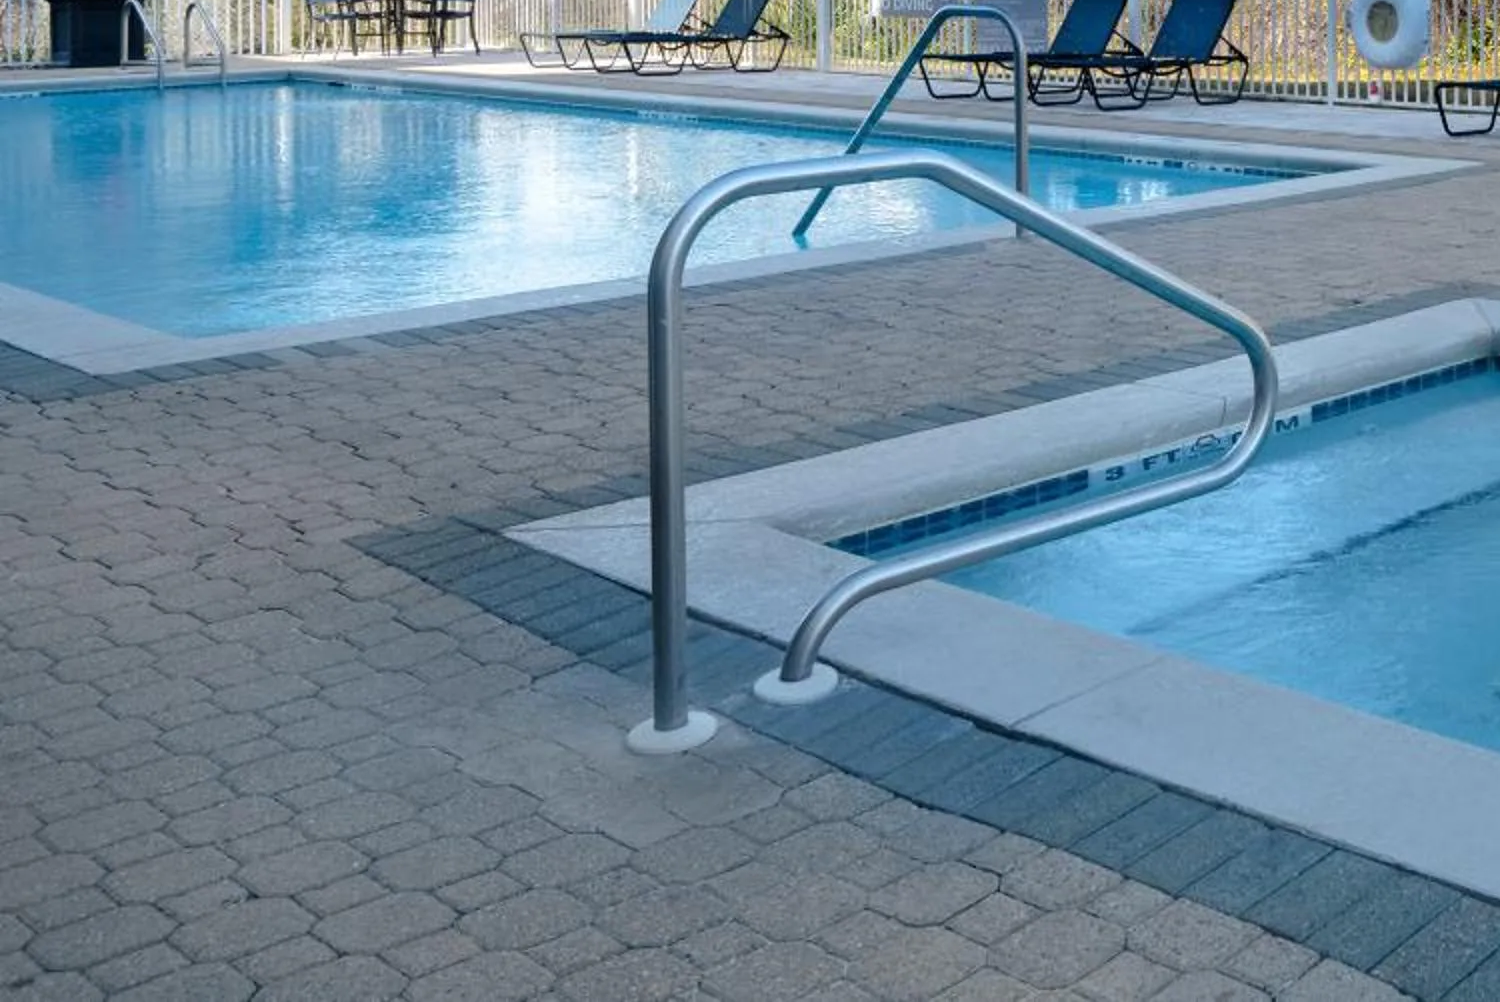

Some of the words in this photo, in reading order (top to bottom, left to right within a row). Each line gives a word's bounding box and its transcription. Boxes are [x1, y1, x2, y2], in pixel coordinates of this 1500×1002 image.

[1275, 415, 1299, 433] M
[1105, 465, 1125, 481] 3
[1142, 447, 1181, 471] FT
